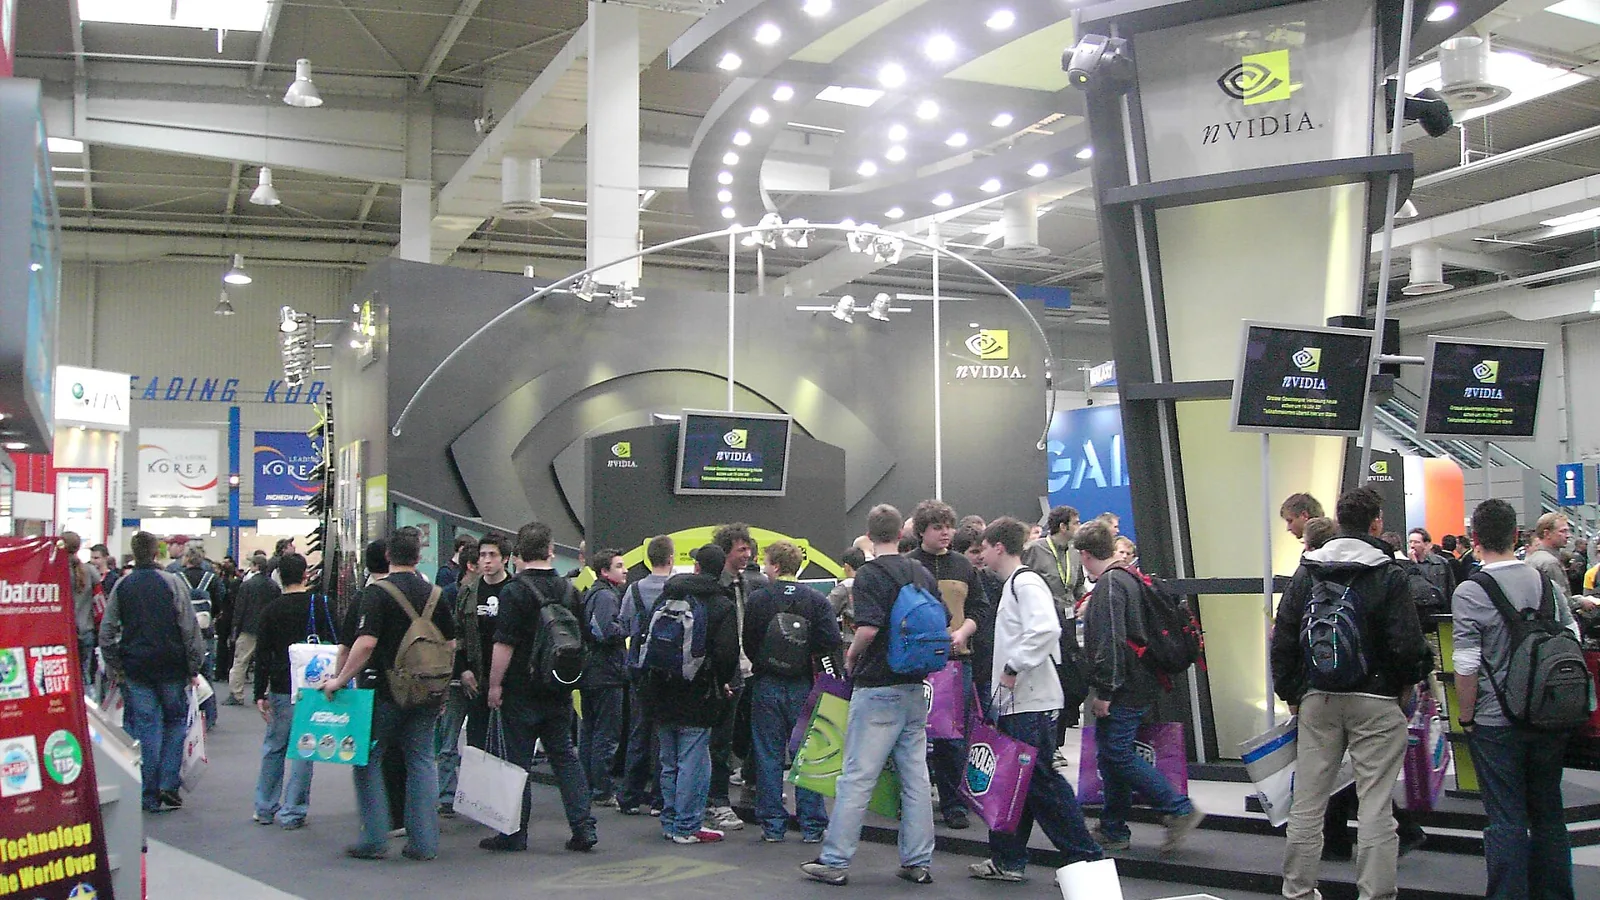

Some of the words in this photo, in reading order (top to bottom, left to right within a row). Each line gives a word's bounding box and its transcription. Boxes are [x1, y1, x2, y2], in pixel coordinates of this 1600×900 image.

[148, 462, 207, 475] KOREA
[43, 657, 69, 676] BEST
[44, 675, 70, 694] BUY
[0, 822, 92, 863] Technology
[19, 856, 65, 890] World
[65, 853, 97, 878] Over
